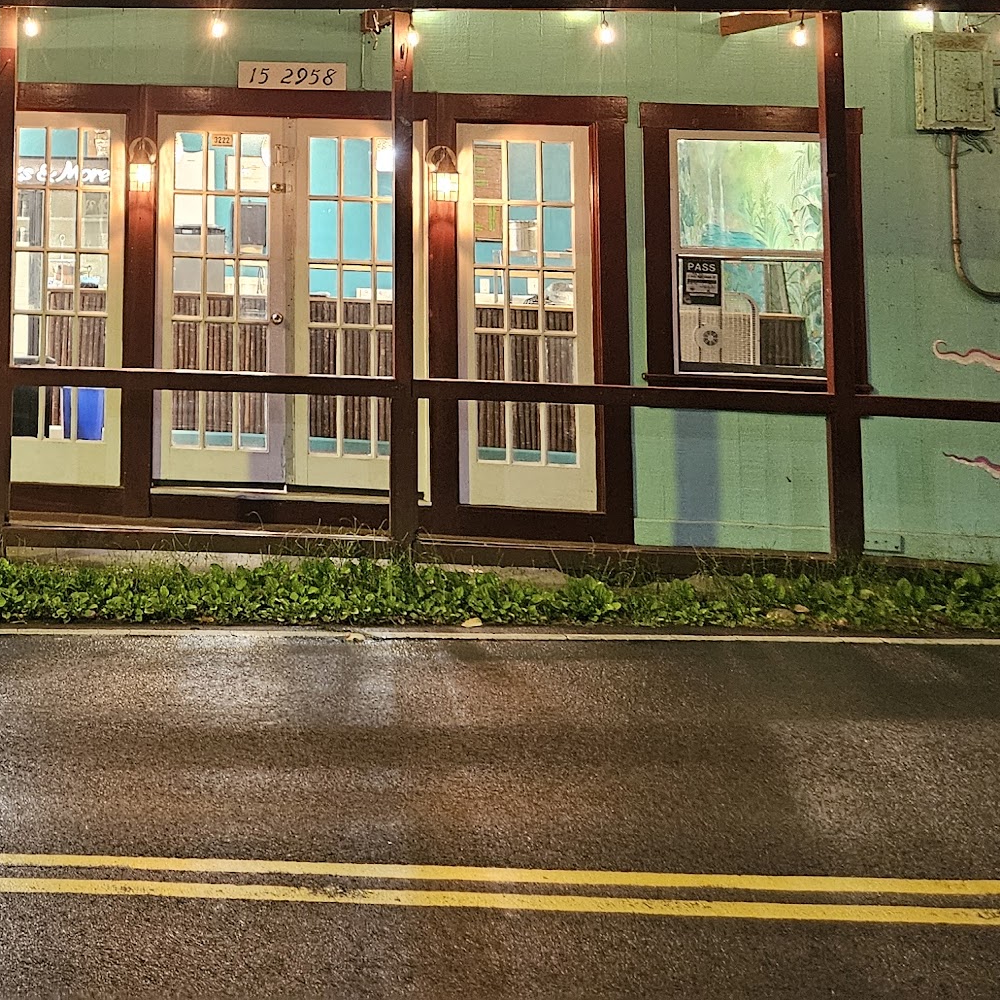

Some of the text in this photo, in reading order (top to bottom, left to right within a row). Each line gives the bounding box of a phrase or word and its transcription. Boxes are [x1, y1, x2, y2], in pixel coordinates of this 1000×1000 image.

[249, 67, 337, 86] 15 2958
[56, 160, 111, 182] More
[687, 262, 716, 272] PASS
